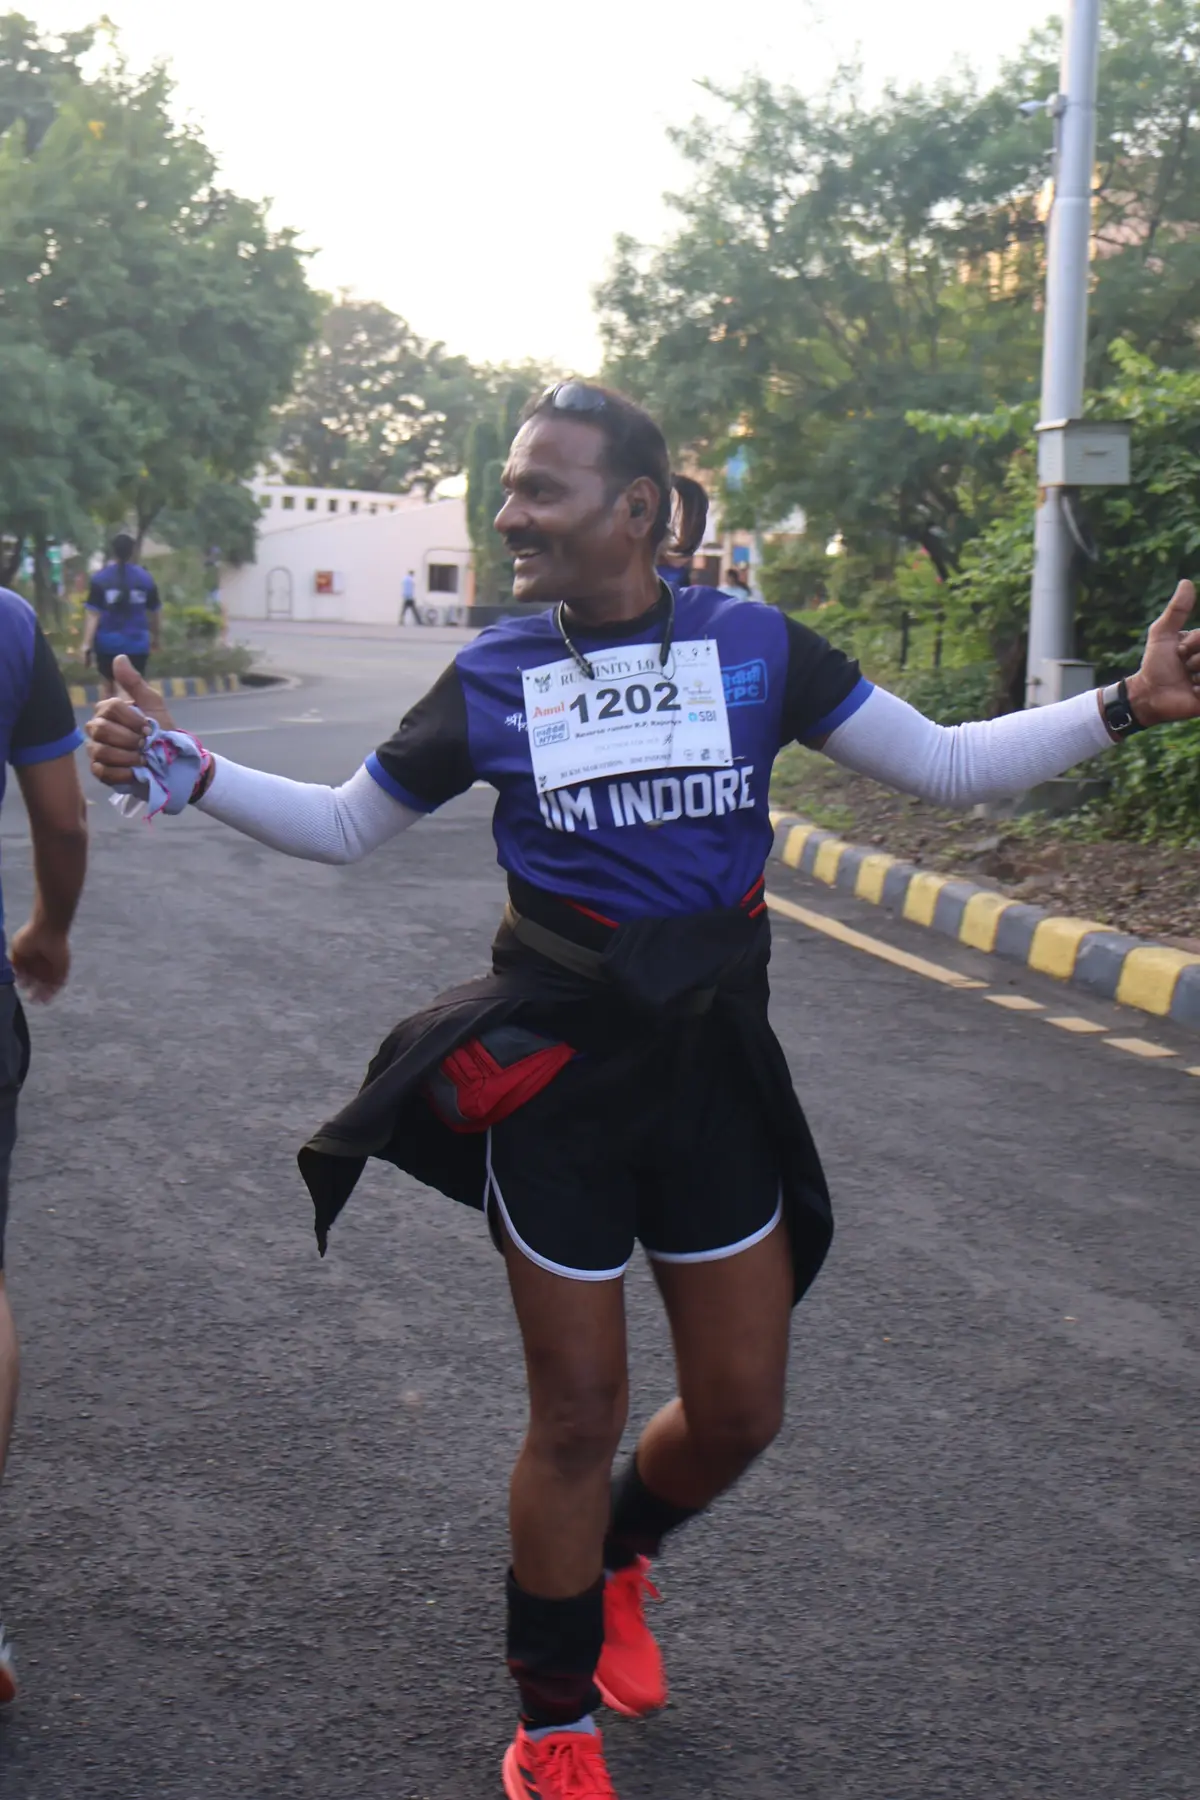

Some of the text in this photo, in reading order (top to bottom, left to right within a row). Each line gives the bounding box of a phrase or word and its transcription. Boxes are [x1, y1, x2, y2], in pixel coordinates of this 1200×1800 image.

[533, 702, 565, 719] Amul
[569, 682, 682, 724] 1202
[698, 710, 717, 722] SBI
[538, 765, 755, 832] IIM INDORE
